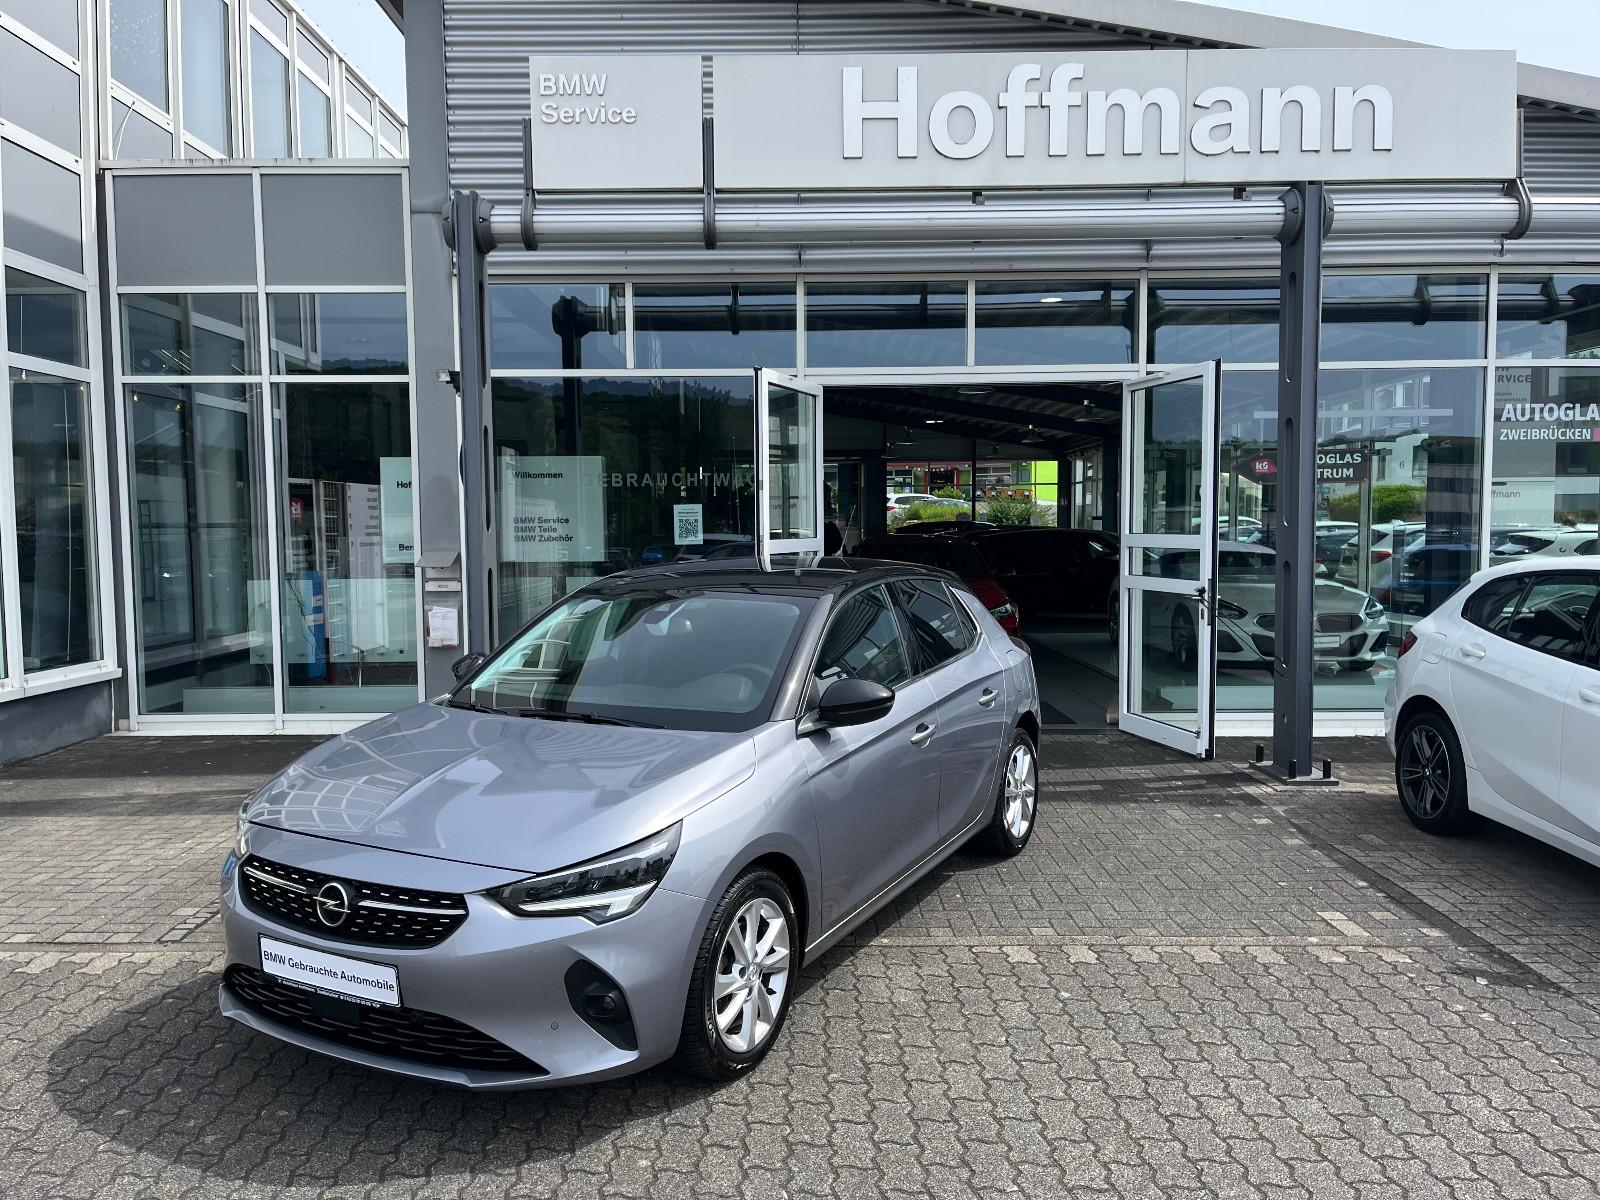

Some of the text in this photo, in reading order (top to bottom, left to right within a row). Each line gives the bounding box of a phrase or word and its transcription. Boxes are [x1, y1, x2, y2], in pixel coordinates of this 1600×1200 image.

[539, 73, 607, 96] BMW
[540, 102, 638, 124] Service
[842, 62, 1394, 159] Hoffmann
[1496, 374, 1532, 384] RVICE
[1500, 402, 1600, 422] AUTOGLA
[1499, 425, 1592, 441] ZWEIBRÜCKEN
[1316, 453, 1362, 465] OGLAS
[513, 471, 564, 479] Willkommen
[1316, 467, 1354, 479] TRUM
[397, 480, 412, 489] Hof
[513, 516, 570, 525] BMW Service
[514, 525, 536, 534] BMW
[514, 534, 537, 543] BMW
[263, 950, 286, 966] BMW
[288, 957, 339, 979] Gebrauchte
[340, 970, 396, 992] Automobile
